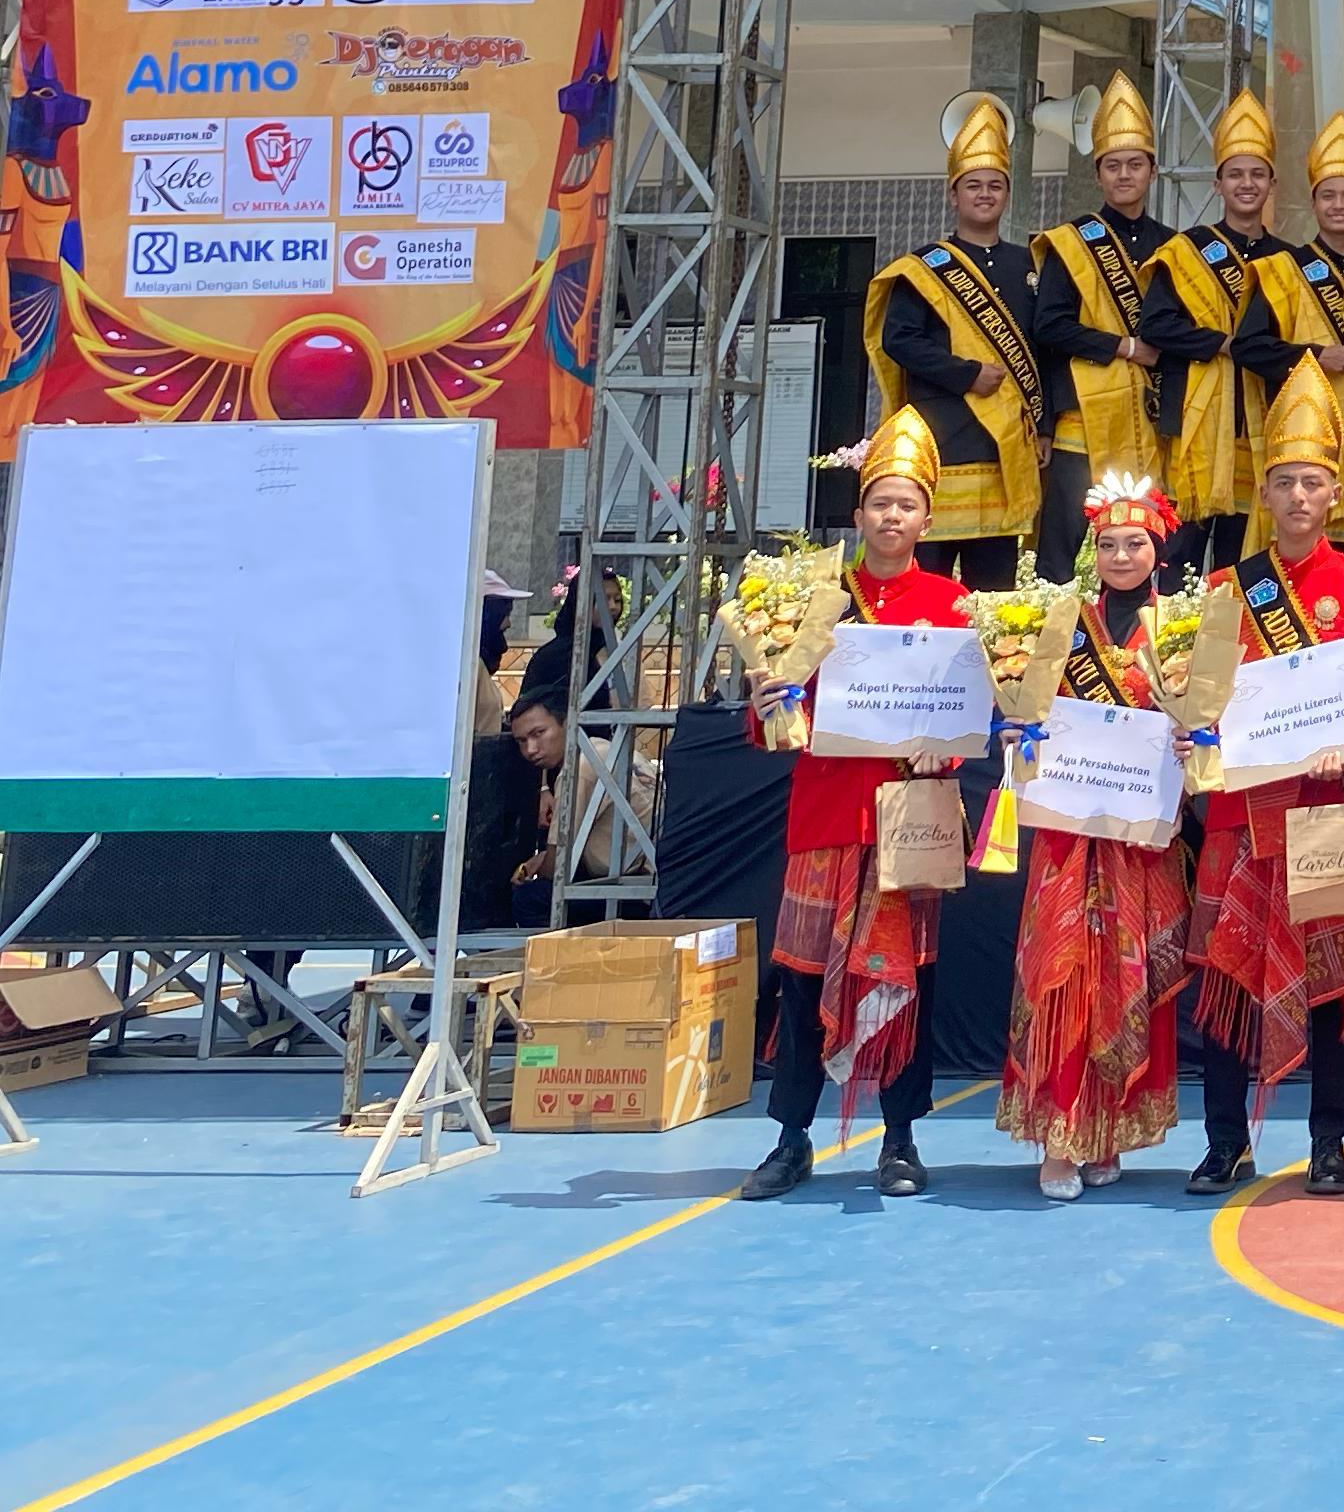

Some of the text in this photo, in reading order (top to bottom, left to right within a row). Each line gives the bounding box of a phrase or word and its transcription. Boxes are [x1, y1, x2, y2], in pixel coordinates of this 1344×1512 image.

[125, 51, 299, 98] Alamo
[377, 62, 460, 79] Printing
[184, 191, 219, 206] Salon
[232, 200, 326, 212] CV MITRA JAYA
[184, 239, 328, 264] BANK BRI
[396, 239, 463, 254] Ganesha
[396, 255, 473, 272] Operation
[1094, 244, 1133, 297] ADIPATI
[134, 277, 327, 293] Melayani Dengan Setulus Hati
[943, 267, 1038, 393] ADIPATI PERSAHABATAN
[1069, 651, 1100, 686] AYU
[848, 681, 966, 696] Adipati Persahabatan
[847, 700, 964, 713] SMAN 2 Malang 2025
[1263, 691, 1344, 721] Adipati Literasi
[1056, 752, 1151, 777] Ayu Persahabatan
[1042, 768, 1154, 795] SMAN 2 Malang 2025
[538, 1068, 647, 1086] JANGAN DIBANTING
